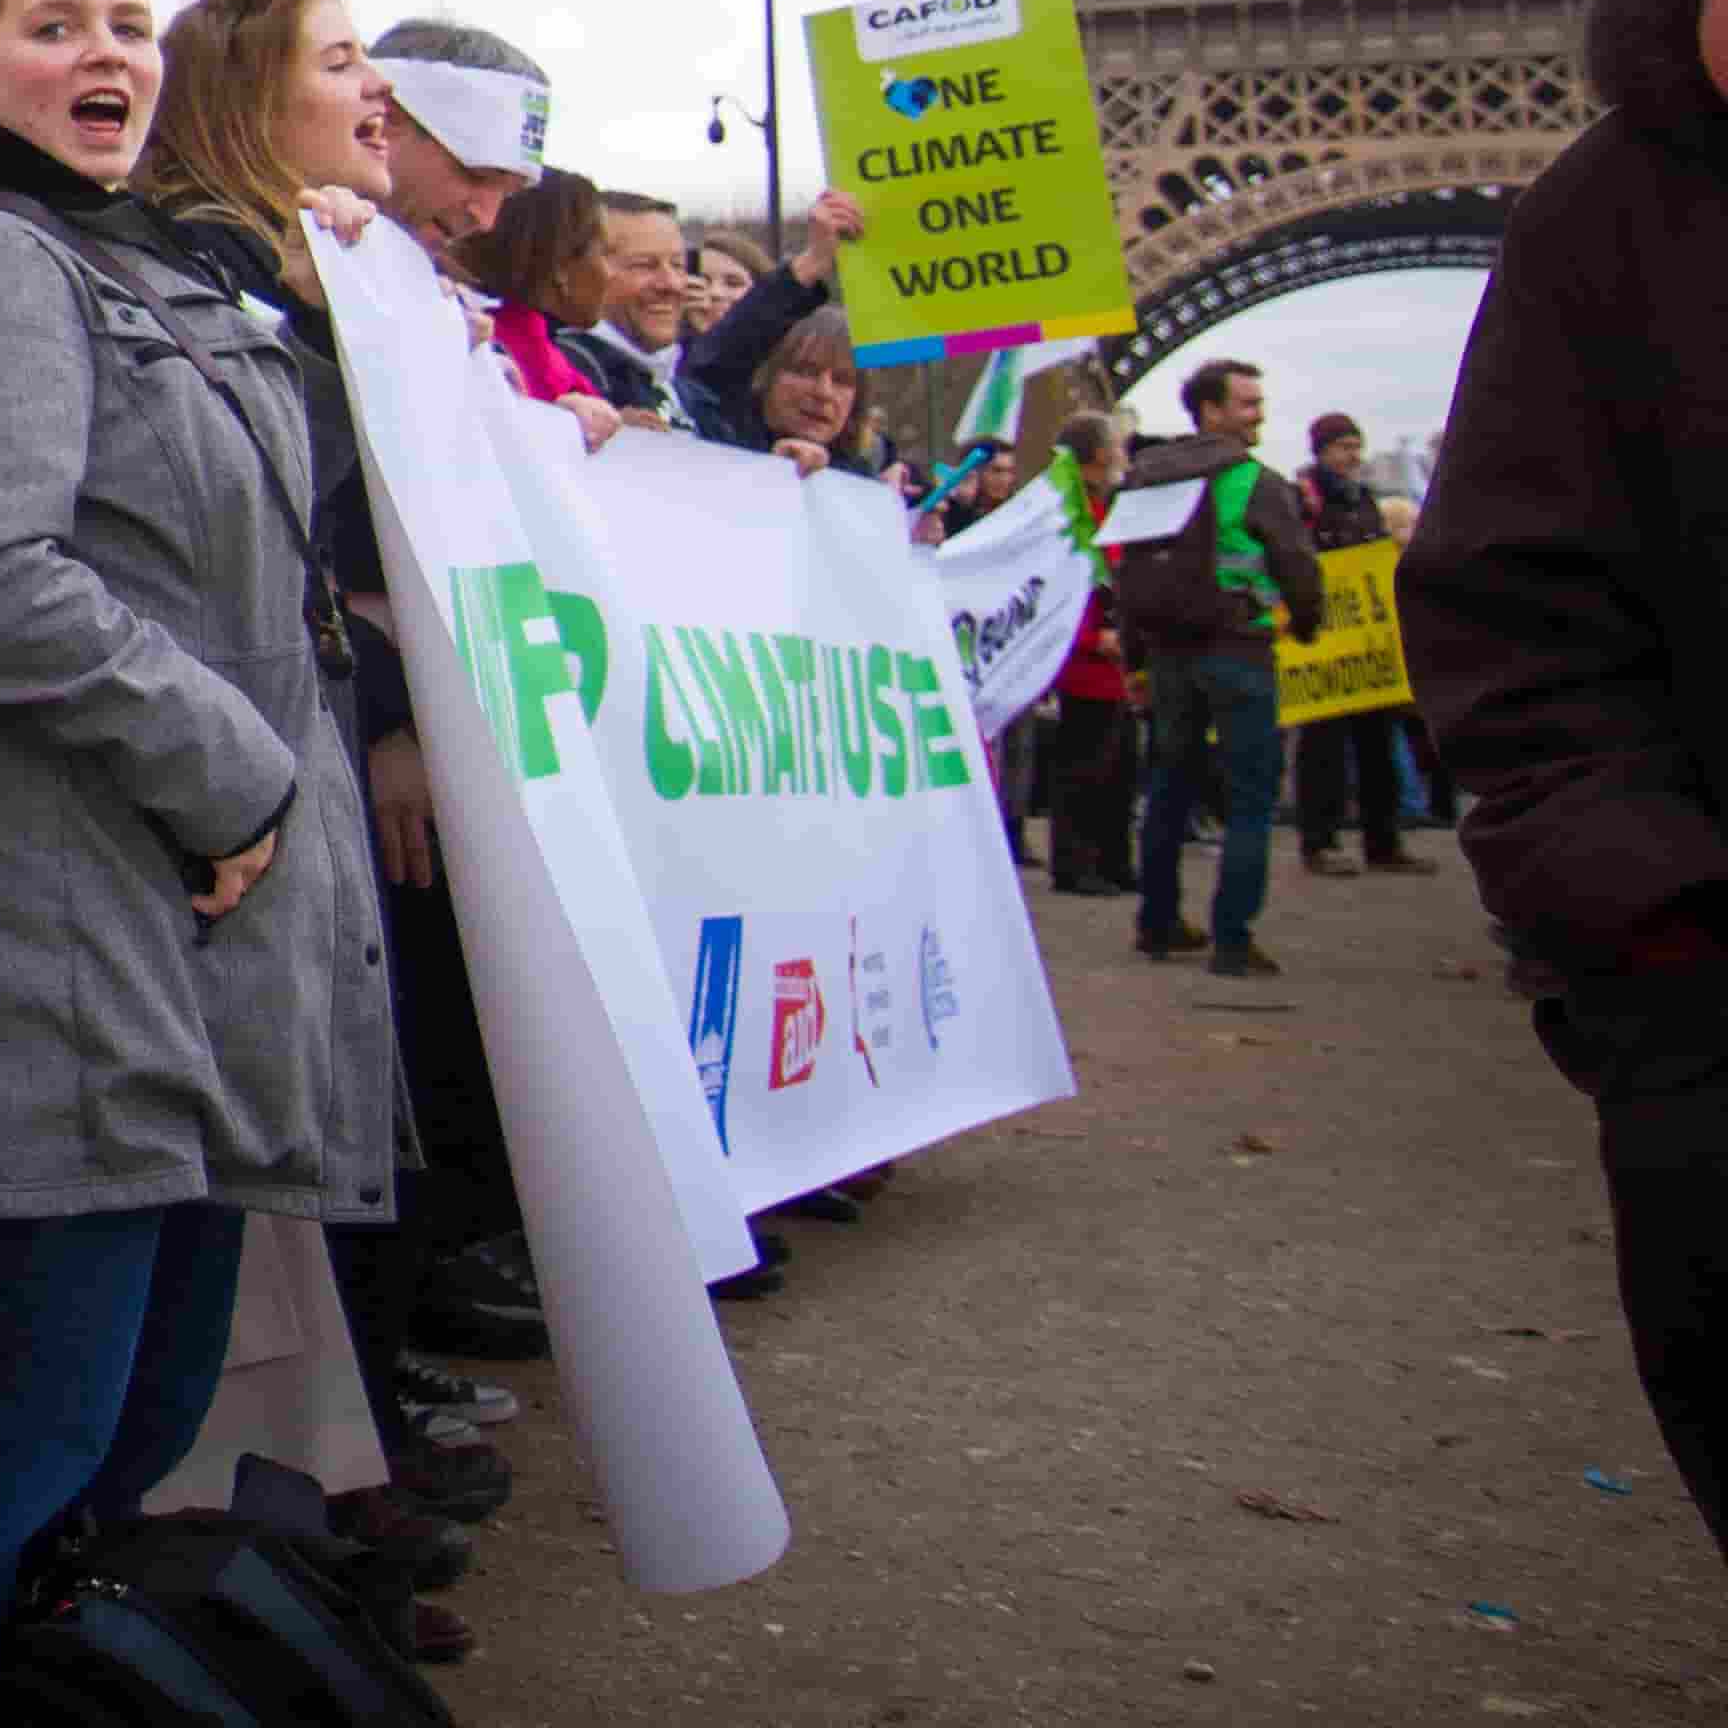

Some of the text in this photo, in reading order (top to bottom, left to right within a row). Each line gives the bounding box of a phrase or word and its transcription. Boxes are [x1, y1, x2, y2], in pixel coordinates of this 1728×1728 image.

[857, 120, 1064, 183] CLIMATE
[918, 187, 1021, 235] ONE
[889, 242, 1070, 299] WORLD
